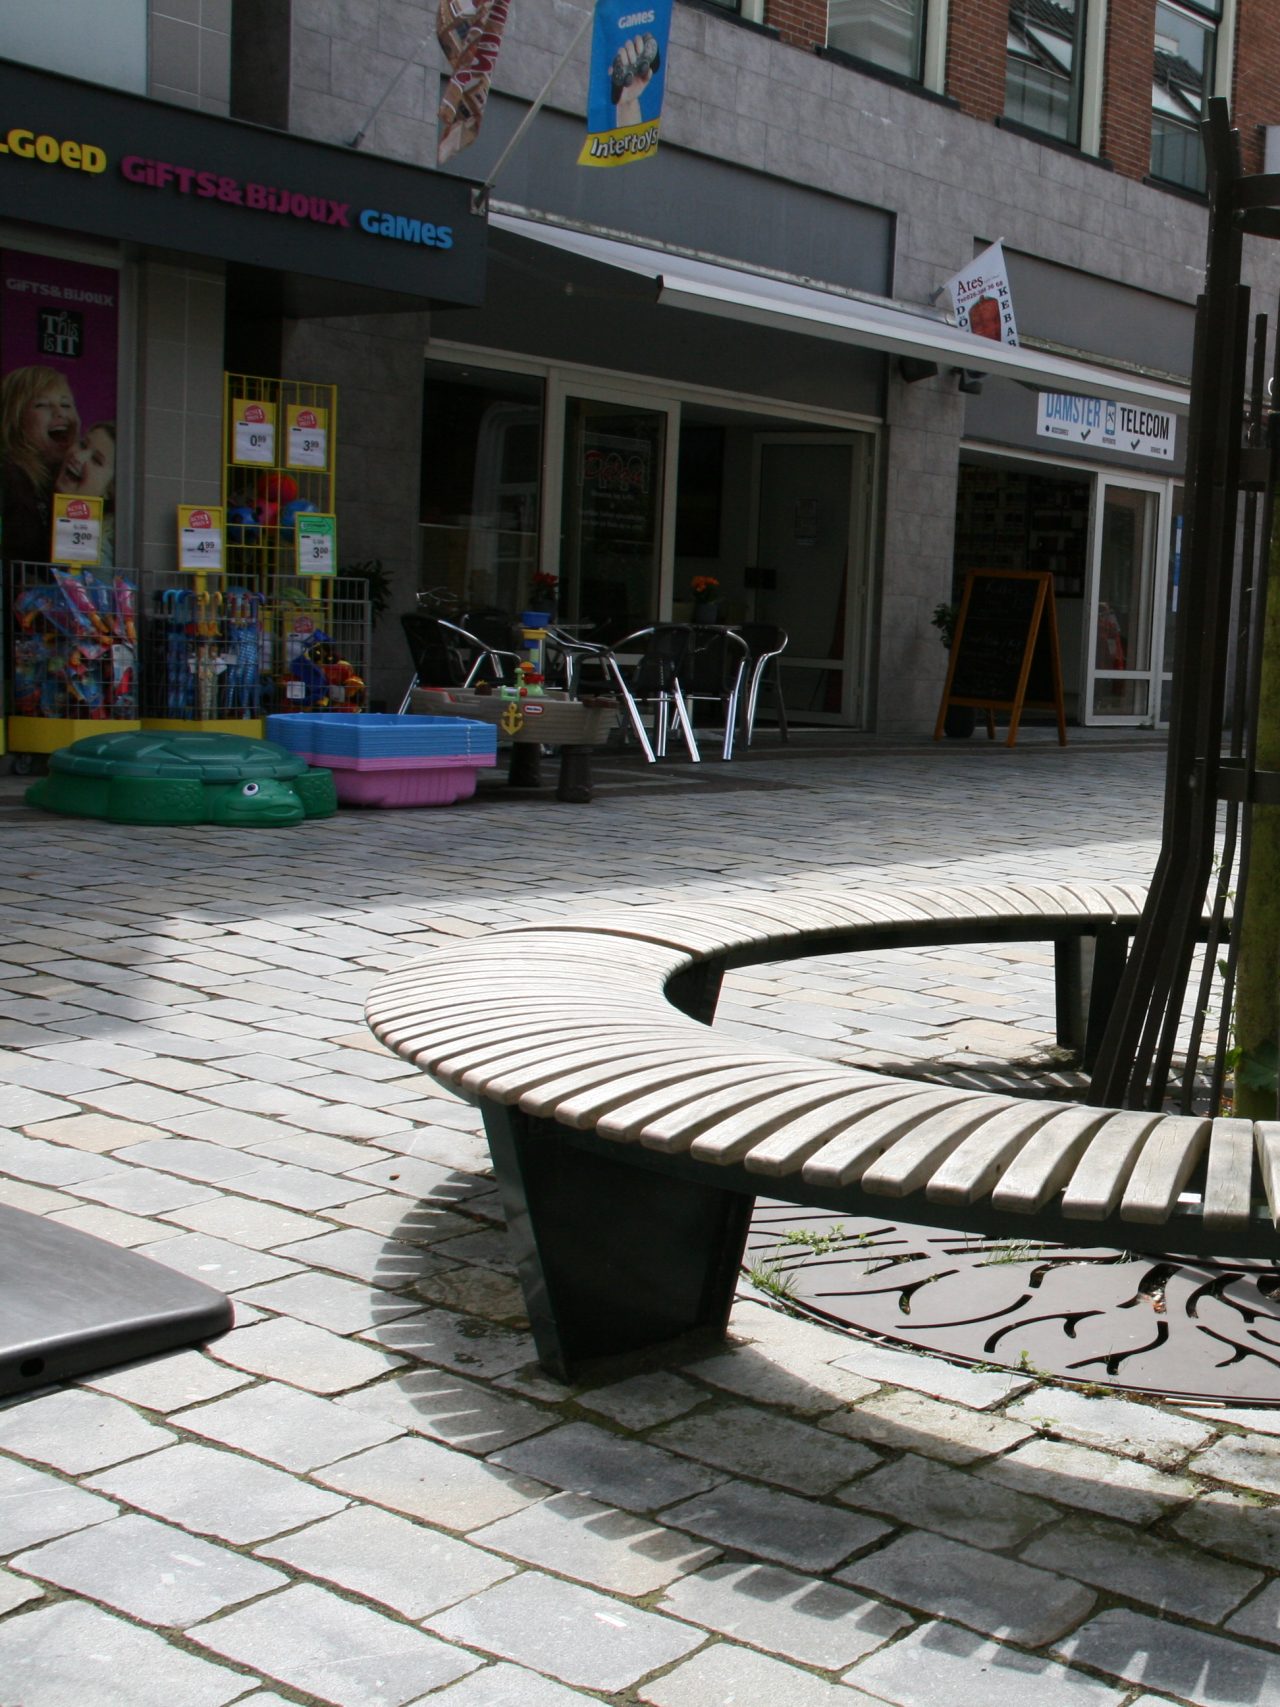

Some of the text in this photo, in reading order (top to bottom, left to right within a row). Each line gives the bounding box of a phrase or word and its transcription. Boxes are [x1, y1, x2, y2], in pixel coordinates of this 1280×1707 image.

[589, 127, 659, 158] Intertoys
[1046, 393, 1170, 440] DAMSTER TELECOM
